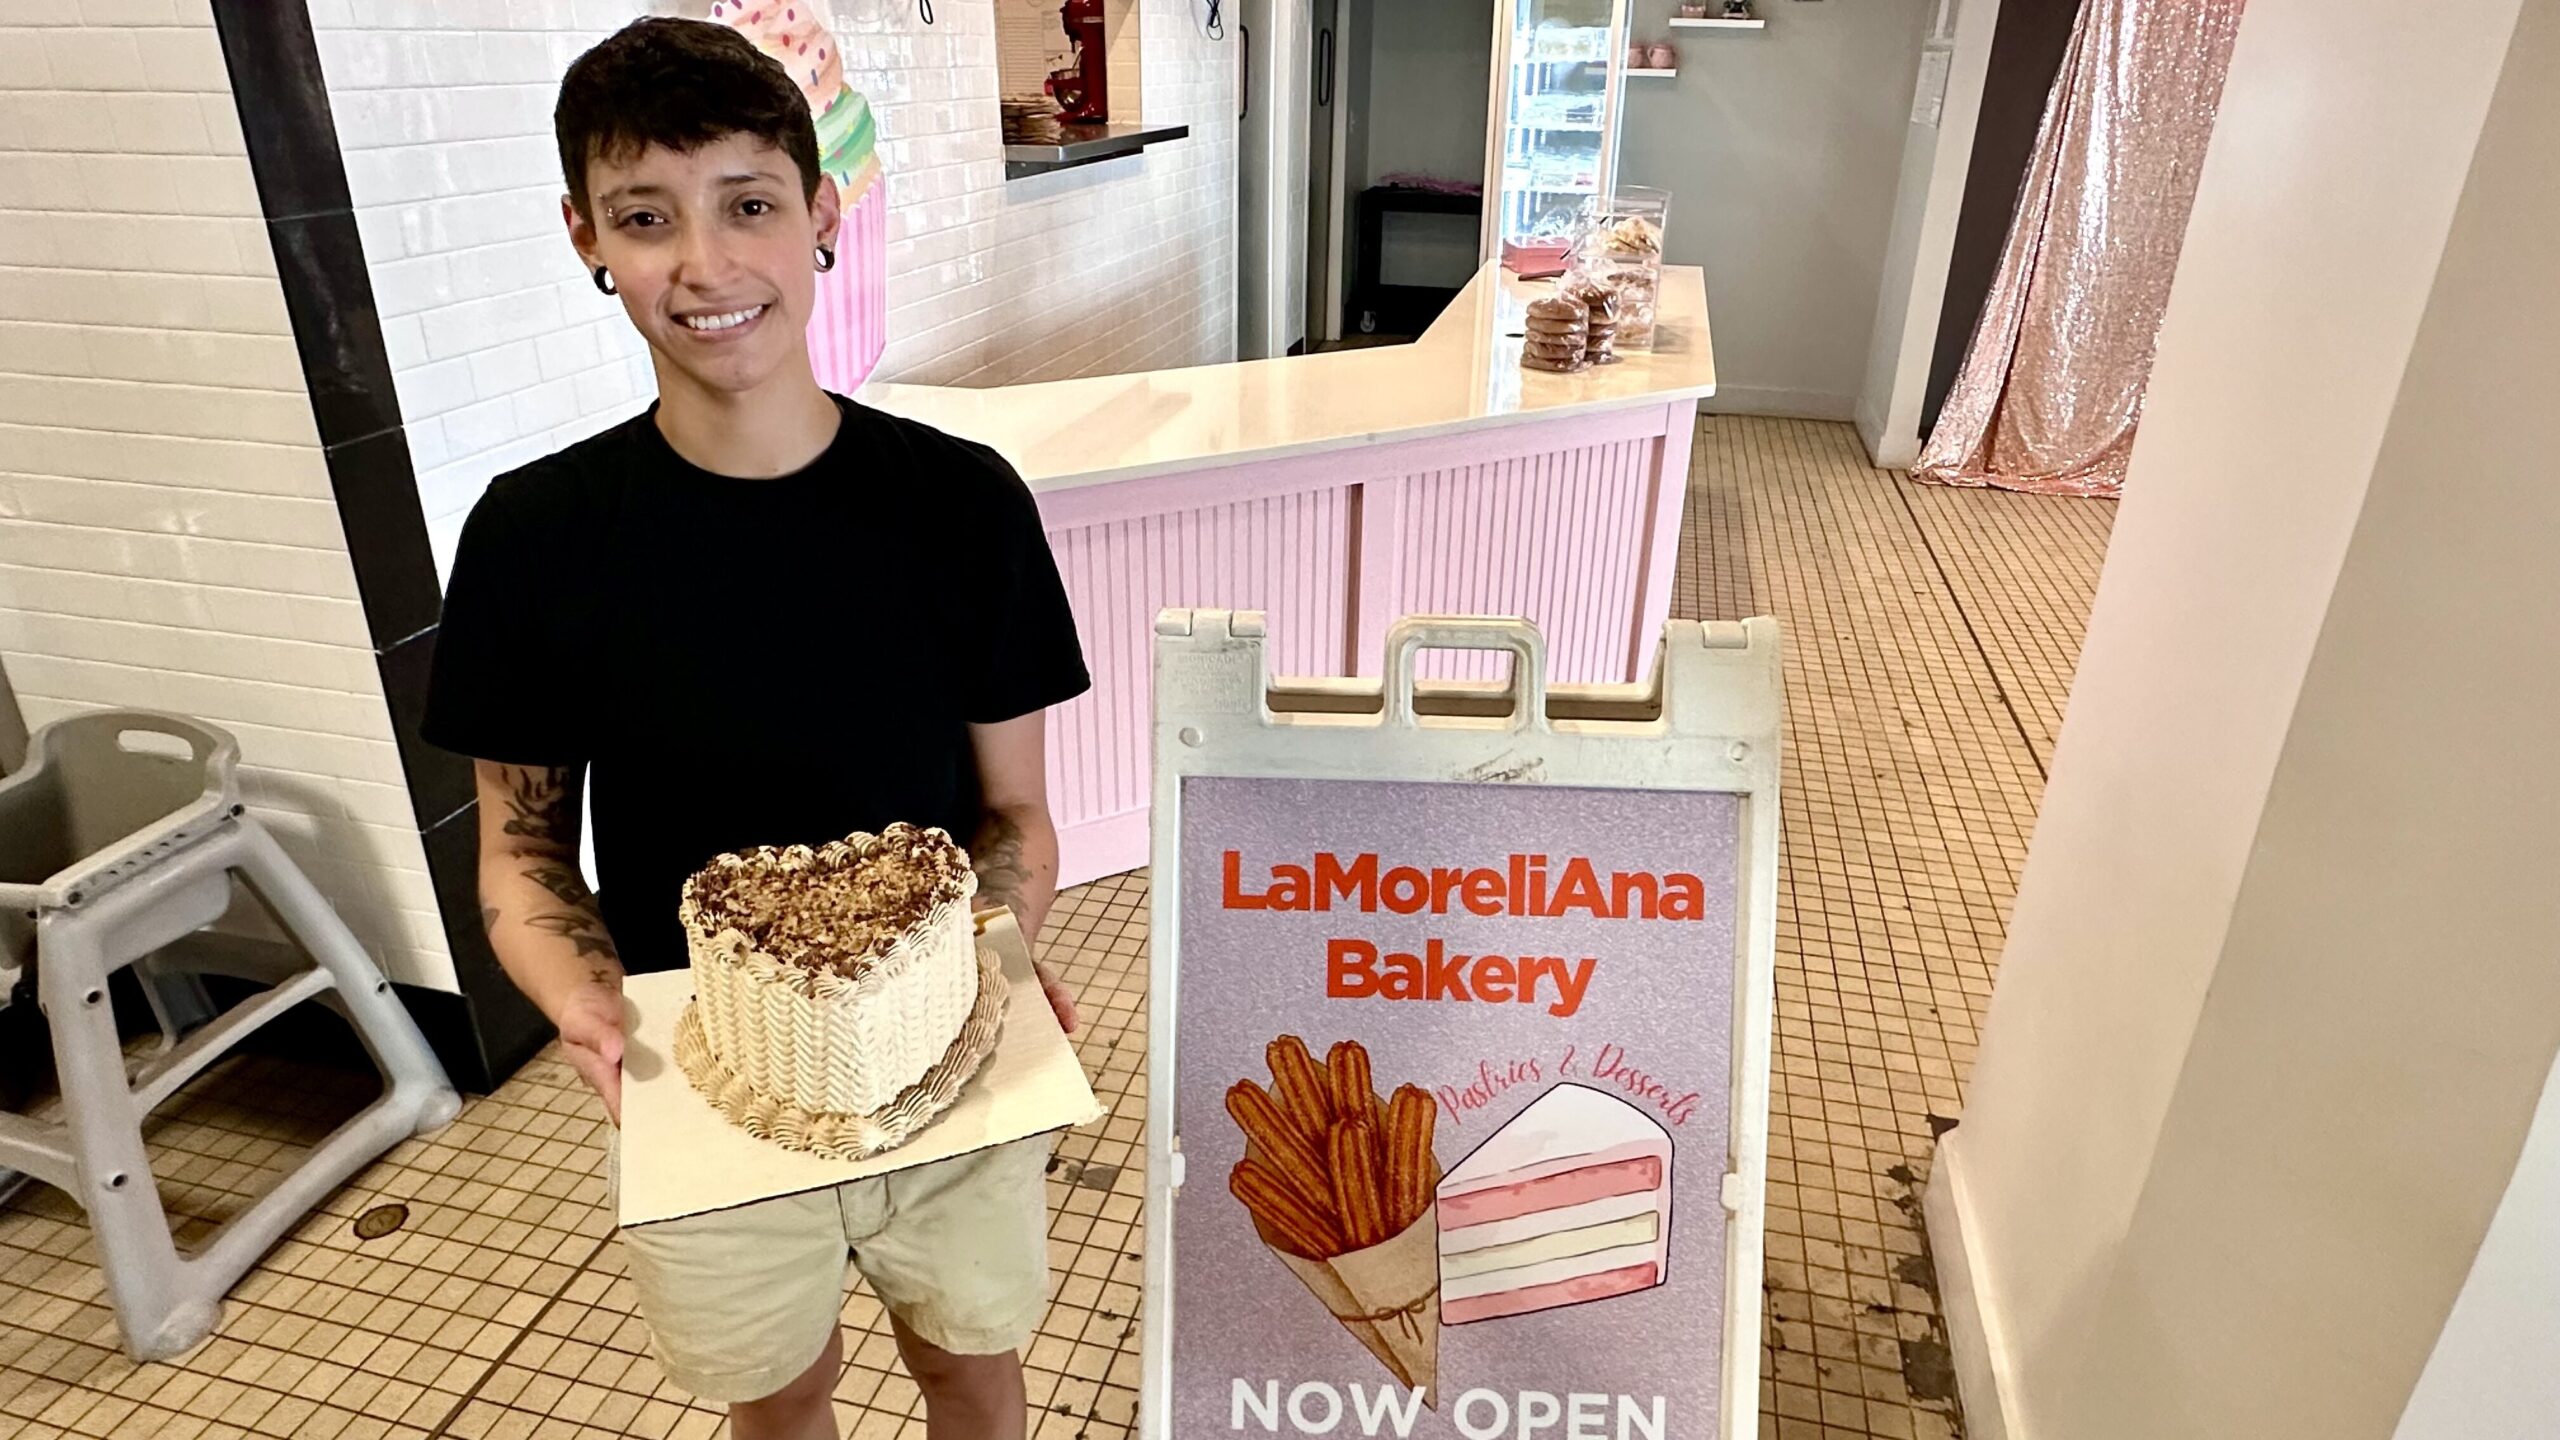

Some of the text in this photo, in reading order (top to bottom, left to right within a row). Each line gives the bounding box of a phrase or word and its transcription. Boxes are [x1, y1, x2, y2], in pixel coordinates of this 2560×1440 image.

[1222, 850, 1705, 920] LaMoreliAna
[1326, 938, 1597, 1018] Bakery
[1437, 1057, 1541, 1125] Pastries
[1592, 1043, 1700, 1126] Desserts
[1231, 1378, 1666, 1440] NOW OPEN
